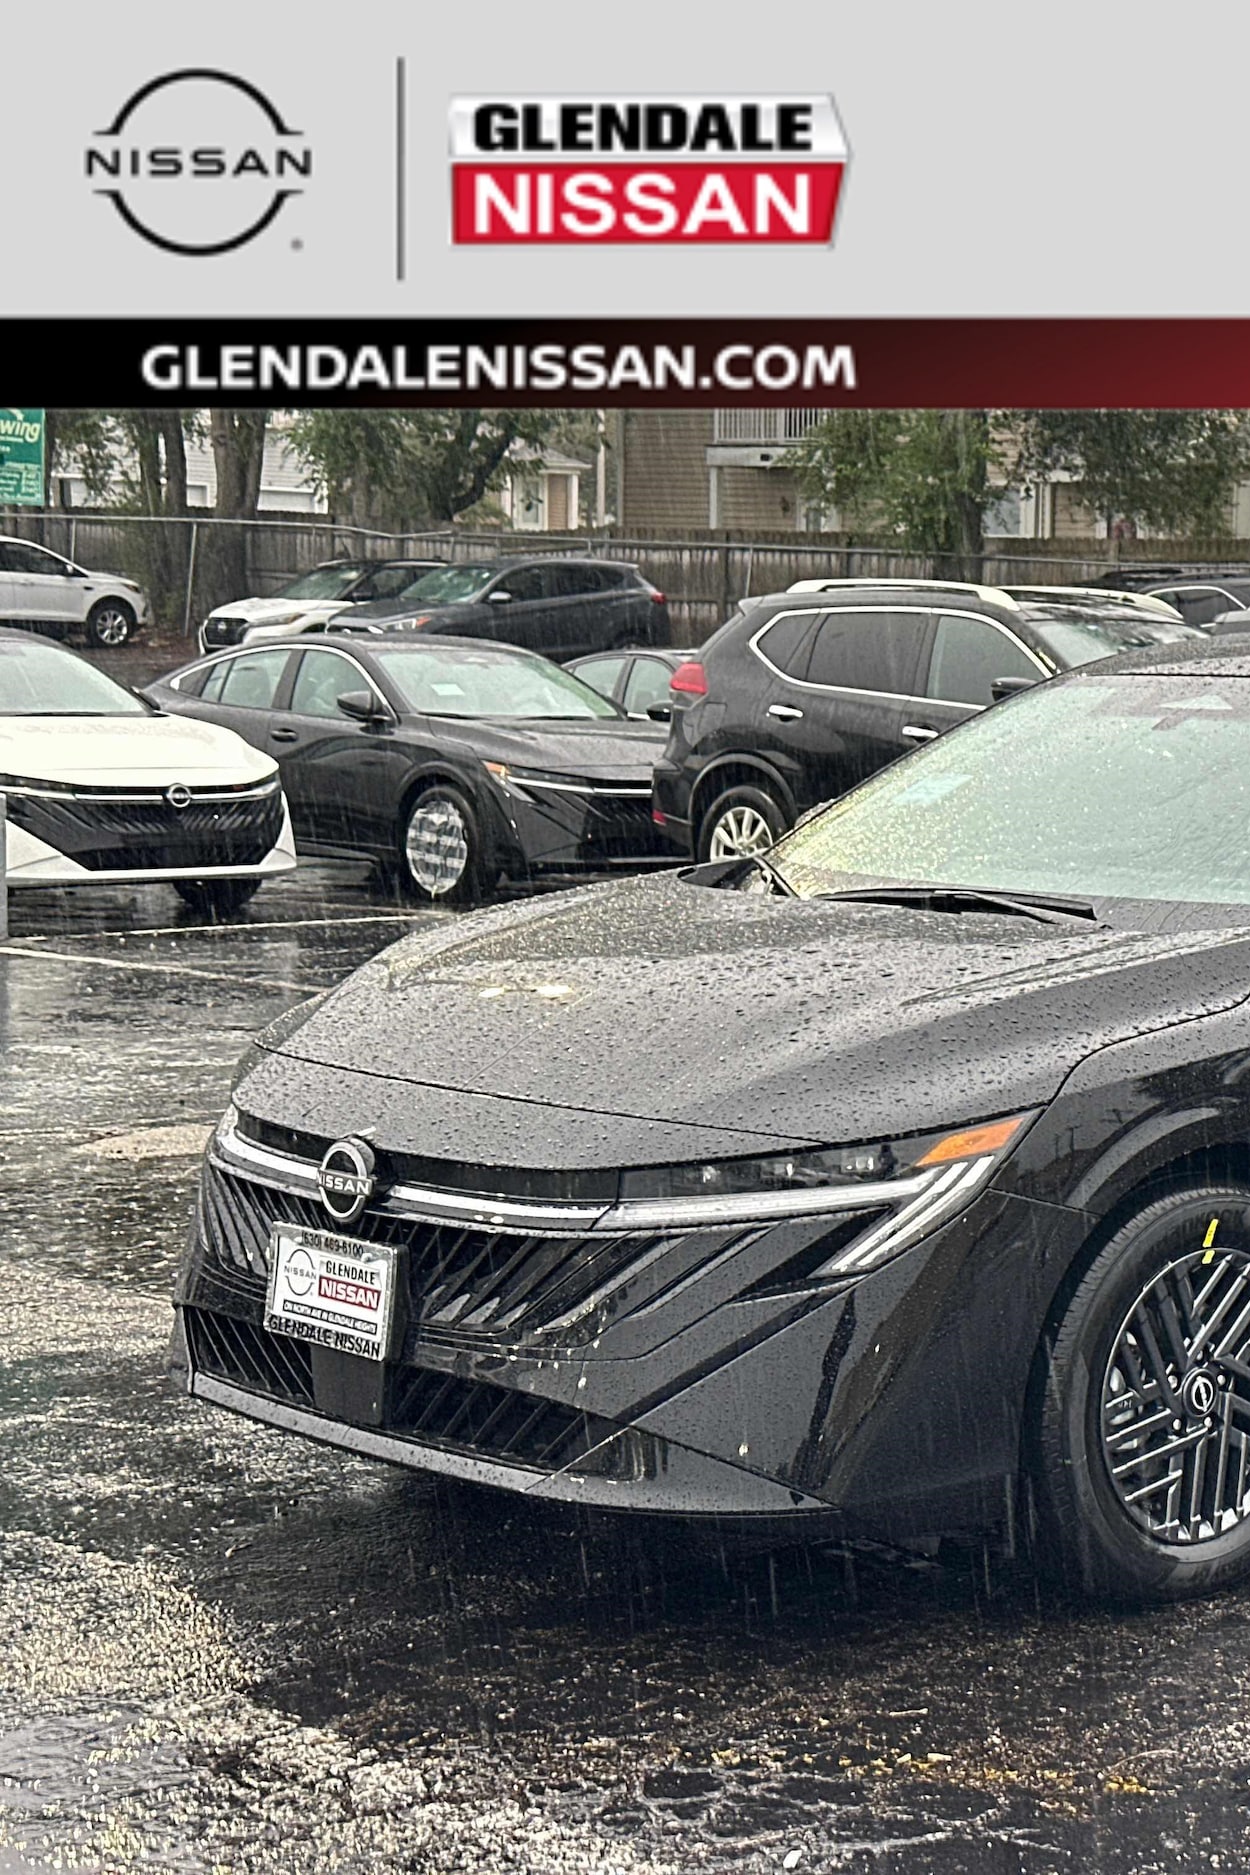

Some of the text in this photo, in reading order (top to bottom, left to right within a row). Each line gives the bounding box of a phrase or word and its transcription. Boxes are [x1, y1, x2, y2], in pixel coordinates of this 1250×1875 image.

[319, 1172, 370, 1196] NISSAN
[284, 1264, 317, 1280] NISSAN
[325, 1260, 376, 1285] GLENDALE
[320, 1278, 379, 1309] NISSAN
[269, 1315, 380, 1358] GLENDALE NISSAN
